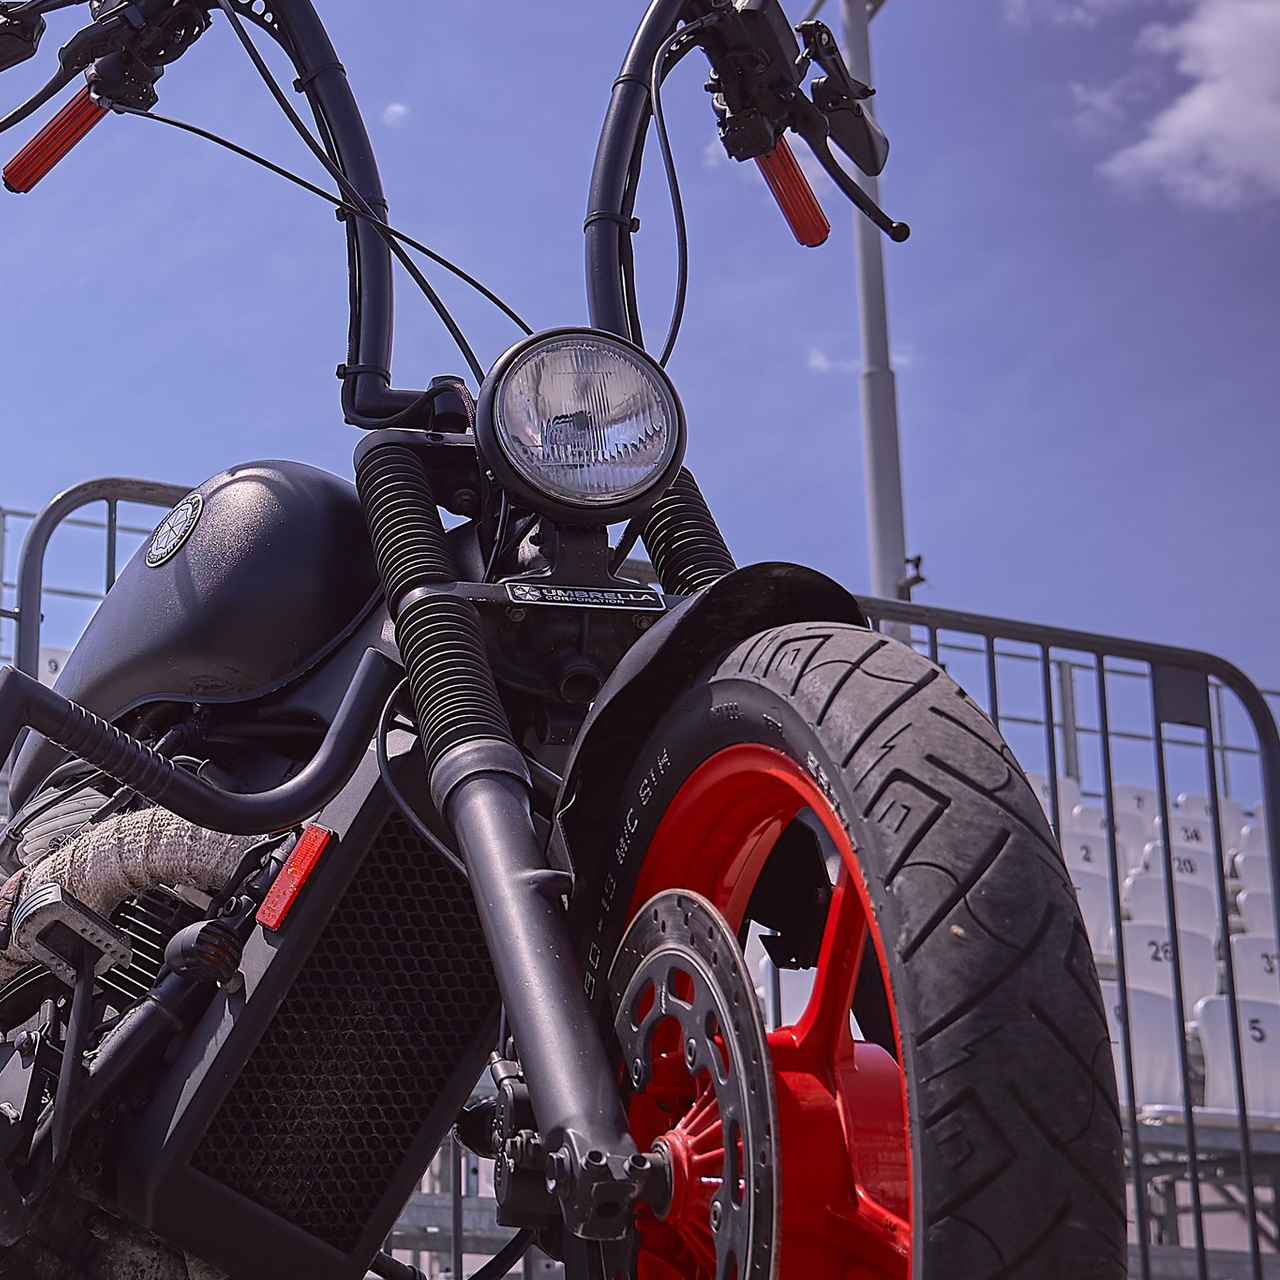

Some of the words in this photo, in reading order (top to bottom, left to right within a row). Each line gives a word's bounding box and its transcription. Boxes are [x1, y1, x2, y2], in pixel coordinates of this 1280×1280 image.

[541, 588, 657, 602] UMBRELLA
[545, 594, 626, 605] CORPORATION
[1079, 844, 1092, 863] 2
[1248, 1018, 1266, 1043] 5
